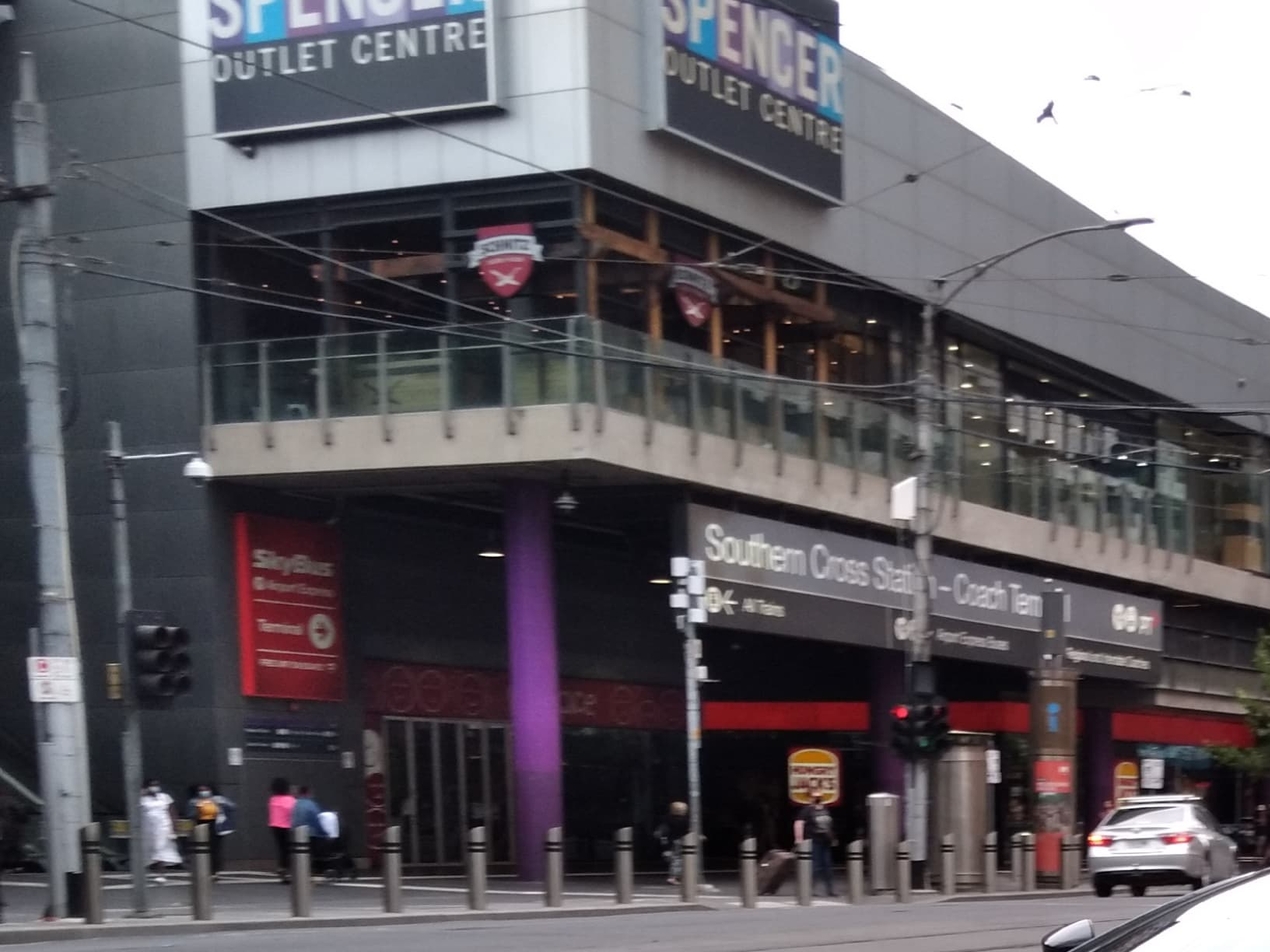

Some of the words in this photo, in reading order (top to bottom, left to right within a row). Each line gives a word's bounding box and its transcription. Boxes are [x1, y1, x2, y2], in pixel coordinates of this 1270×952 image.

[212, 39, 337, 82] OUTLET
[351, 18, 486, 64] CENTRE
[665, 46, 751, 111] OUTLET
[759, 93, 842, 154] CENTRE
[705, 523, 807, 576] Southern
[810, 544, 870, 587] Cross
[872, 556, 937, 599] Statin
[953, 573, 1008, 611] Coach
